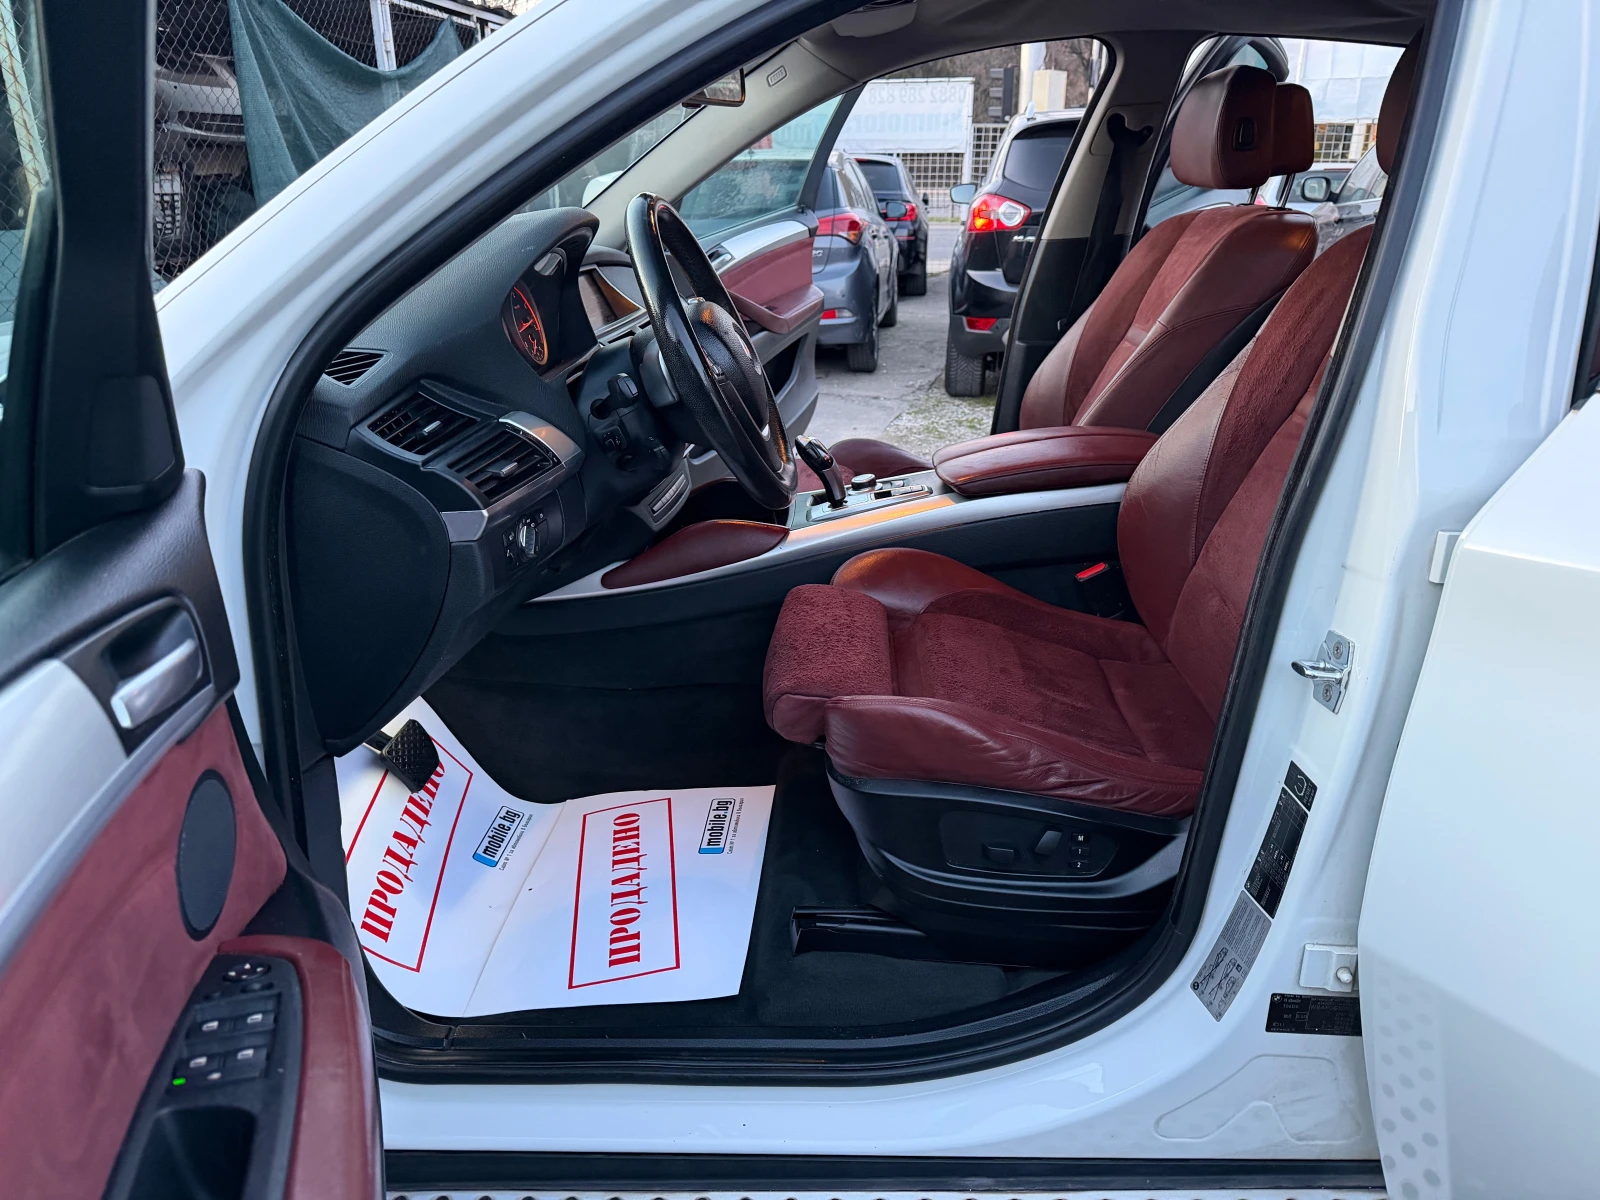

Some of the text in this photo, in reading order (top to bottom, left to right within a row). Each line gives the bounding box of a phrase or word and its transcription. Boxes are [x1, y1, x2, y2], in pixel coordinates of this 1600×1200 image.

[482, 809, 521, 858] mobile.bg
[706, 800, 733, 847] mobile.bg
[608, 812, 648, 968] ПРОДАДЕНО
